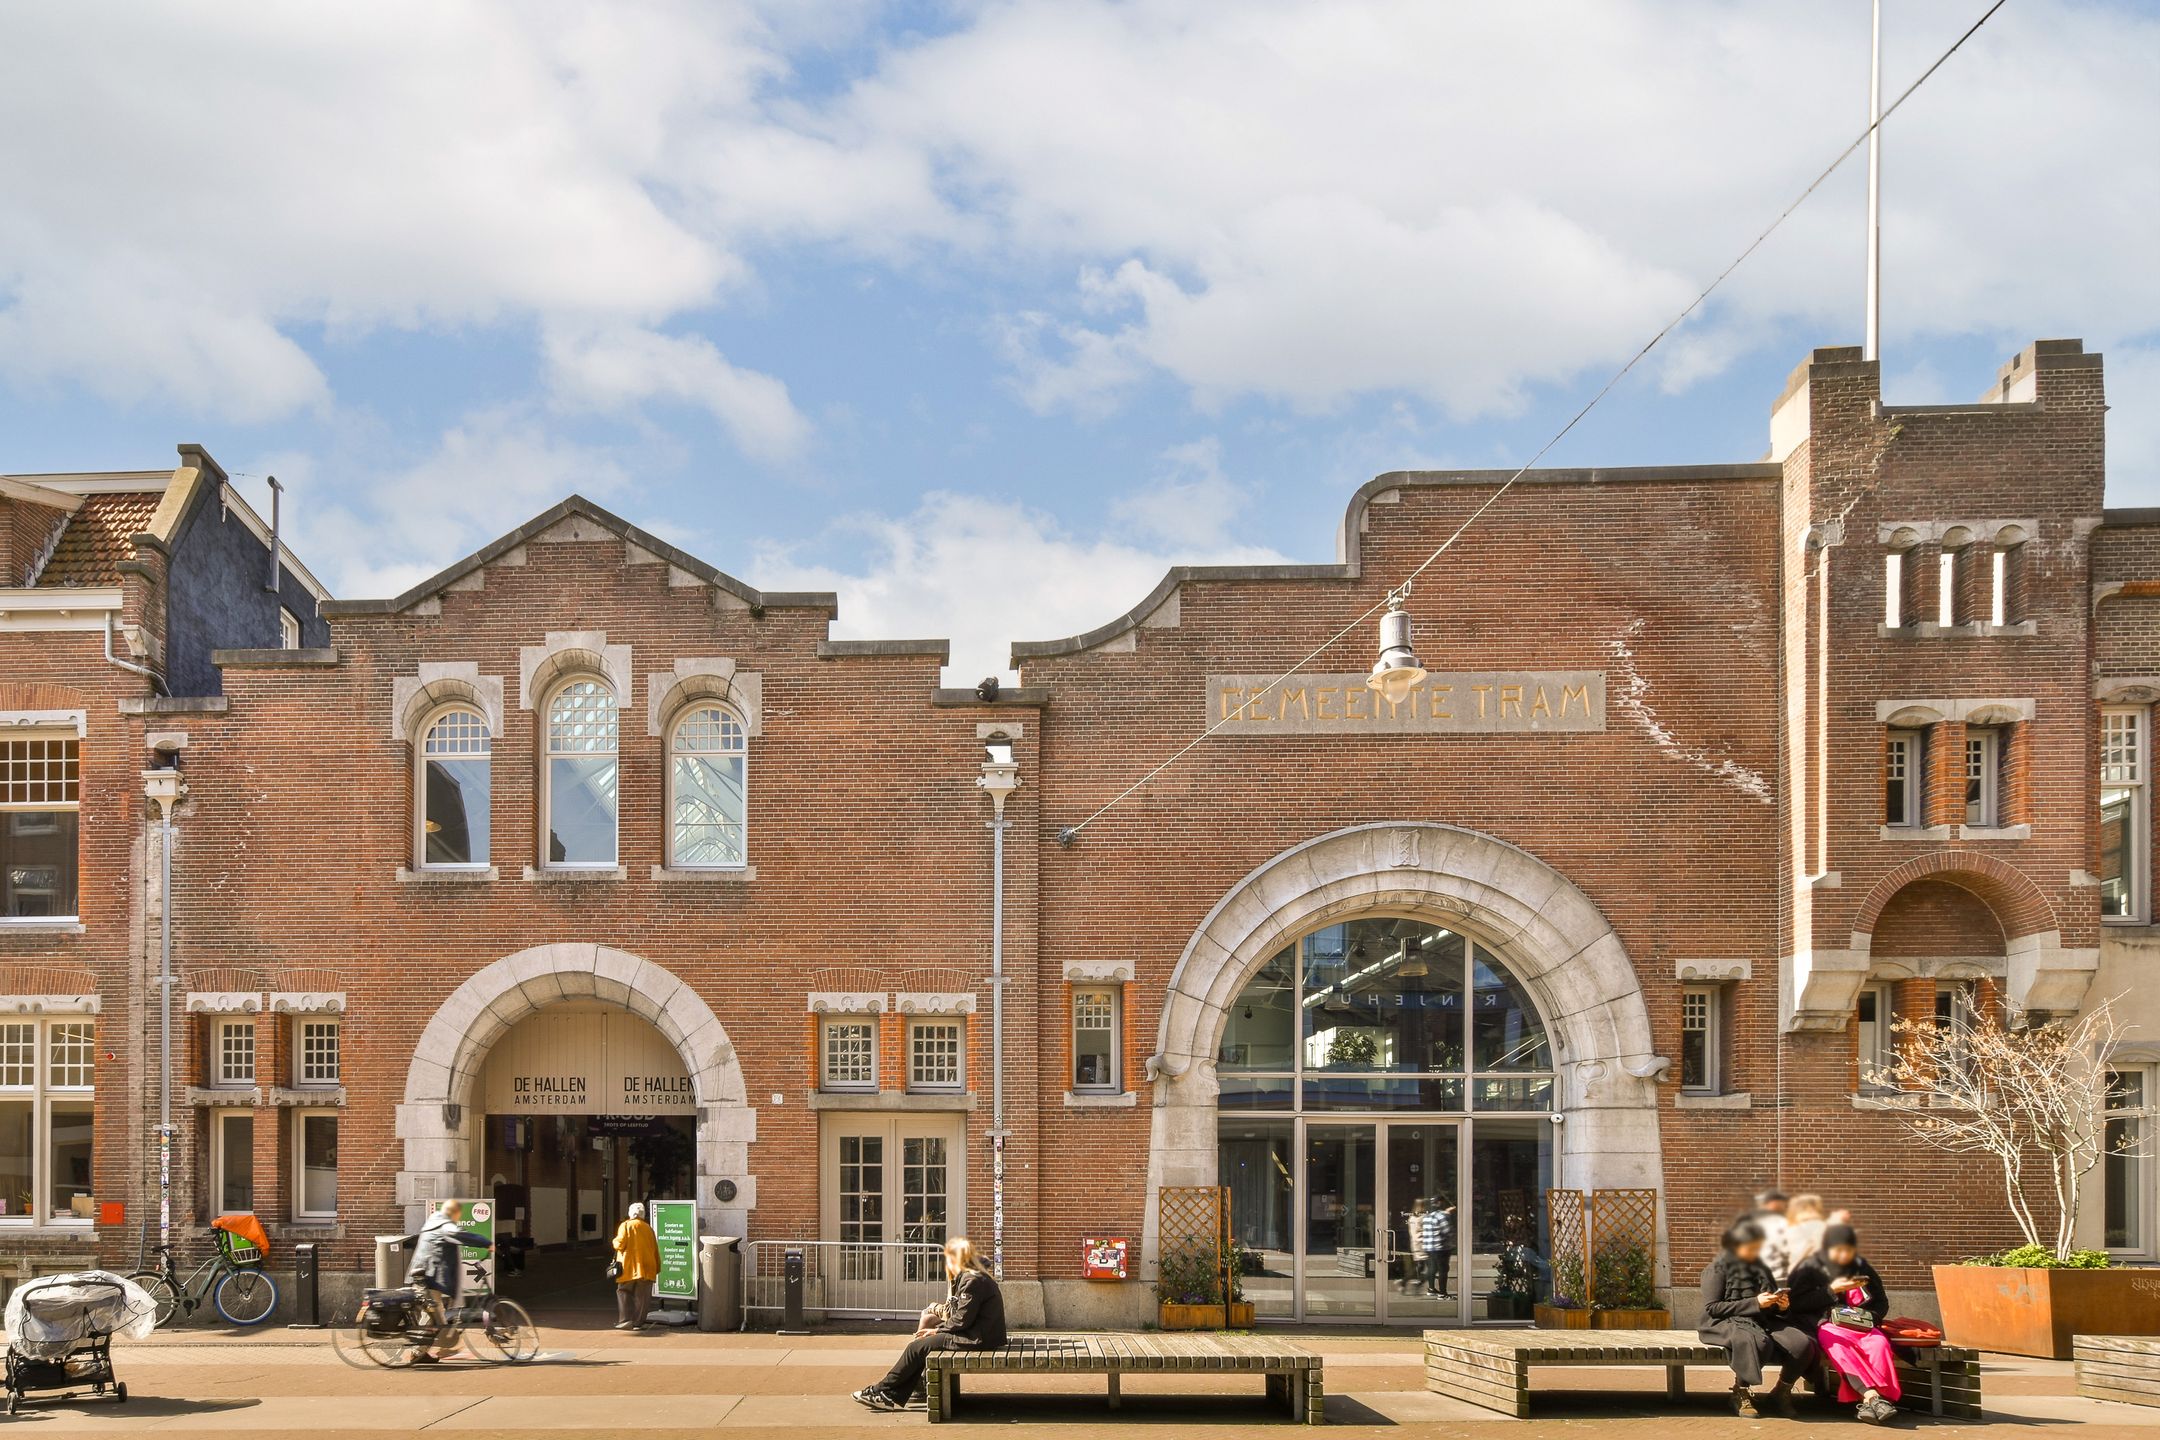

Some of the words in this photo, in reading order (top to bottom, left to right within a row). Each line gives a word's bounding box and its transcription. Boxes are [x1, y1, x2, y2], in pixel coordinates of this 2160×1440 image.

[1219, 685, 1454, 721] GEMEENTE
[1471, 683, 1592, 720] TRAM
[514, 1077, 530, 1092] DE
[534, 1077, 586, 1092] HALLEN
[624, 1076, 640, 1092] DE
[644, 1077, 695, 1092] HALLEN
[514, 1095, 586, 1105] AMSTERDAM
[624, 1094, 697, 1105] AMSTERDAM
[460, 1249, 478, 1258] llen
